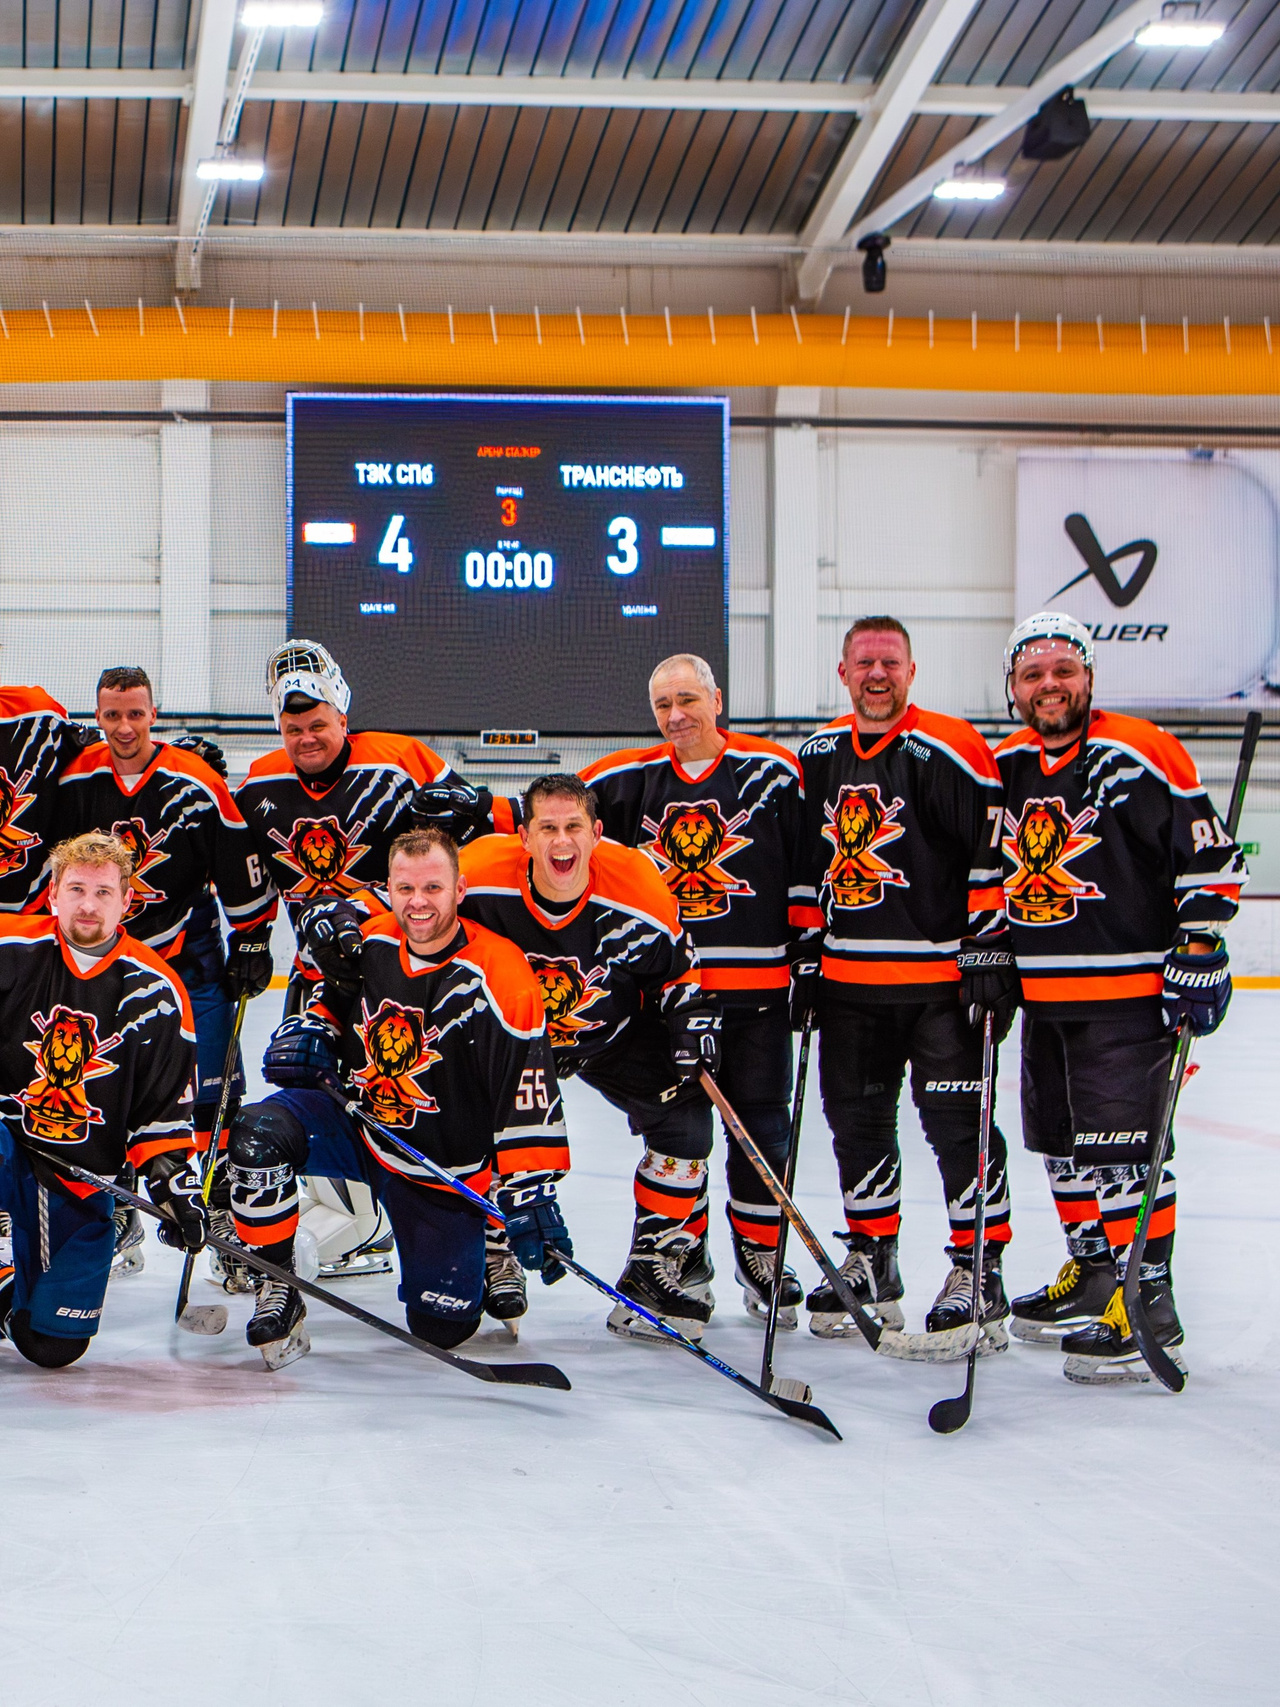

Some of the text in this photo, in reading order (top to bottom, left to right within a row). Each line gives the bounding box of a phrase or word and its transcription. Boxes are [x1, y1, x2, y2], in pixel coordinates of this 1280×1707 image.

[355, 463, 393, 485] ТЭК
[560, 465, 684, 489] ТРАНСНЕФТЬ
[501, 498, 517, 526] 3
[377, 514, 414, 573] 4
[606, 516, 640, 575] 3
[465, 552, 553, 588] 00:00
[1083, 624, 1169, 642] UER
[238, 943, 269, 953] BAU
[276, 1018, 327, 1038] CC
[686, 1016, 722, 1031] CC
[515, 1068, 549, 1111] 55
[1074, 1130, 1148, 1146] BAUER
[510, 1182, 558, 1207] CC
[420, 1290, 472, 1310] CCM
